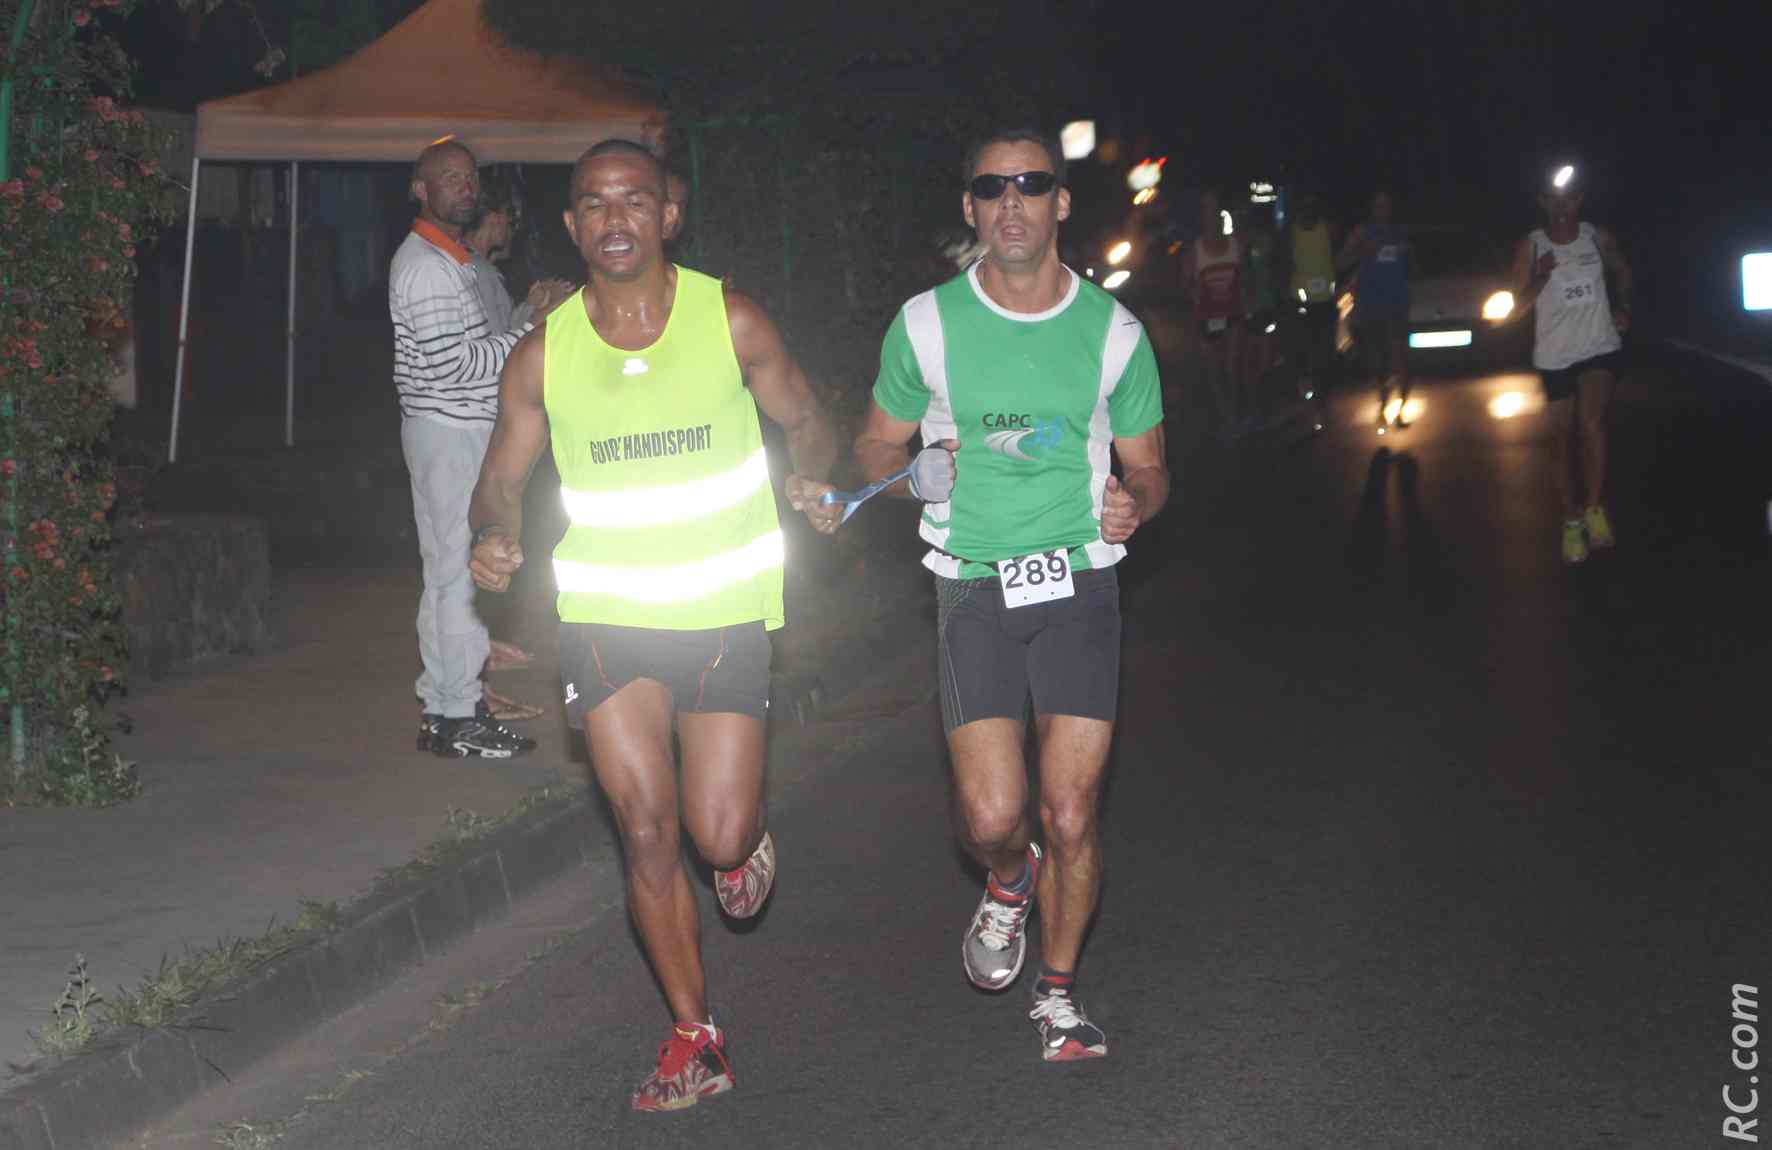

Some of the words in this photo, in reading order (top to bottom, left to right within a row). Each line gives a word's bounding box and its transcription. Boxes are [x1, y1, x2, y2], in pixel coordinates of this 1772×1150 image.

[1564, 283, 1593, 300] 261
[981, 412, 1033, 428] CAPC
[1003, 556, 1067, 589] 289
